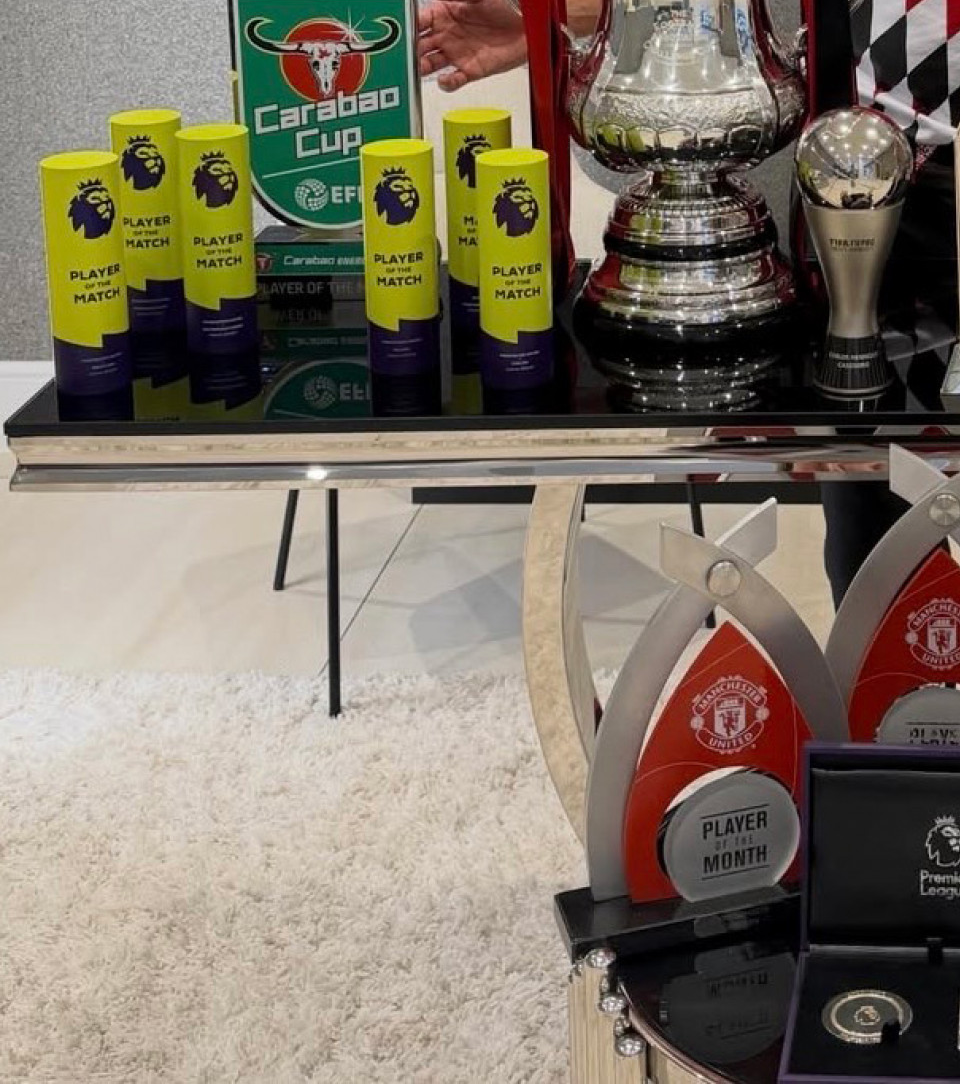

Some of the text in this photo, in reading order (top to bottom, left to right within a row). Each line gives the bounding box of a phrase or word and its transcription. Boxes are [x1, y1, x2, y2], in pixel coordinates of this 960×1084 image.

[254, 86, 400, 135] Carabao
[296, 127, 362, 159] Cup
[123, 215, 171, 228] PLAYER
[125, 237, 170, 248] MATCH
[193, 233, 243, 246] PLAYER
[196, 255, 242, 269] MATCH
[284, 255, 335, 266] Carabao
[374, 252, 423, 264] PLAYER
[69, 263, 121, 281] PLAYER
[492, 263, 542, 276] PLAYER
[377, 275, 422, 287] MATCH
[309, 282, 325, 294] OF
[495, 287, 541, 300] MATCH
[73, 287, 120, 305] MATCH
[699, 681, 761, 710] MANCHESTER
[709, 732, 753, 748] UNITED
[703, 811, 767, 840] PLAYER
[703, 844, 767, 873] MONTH
